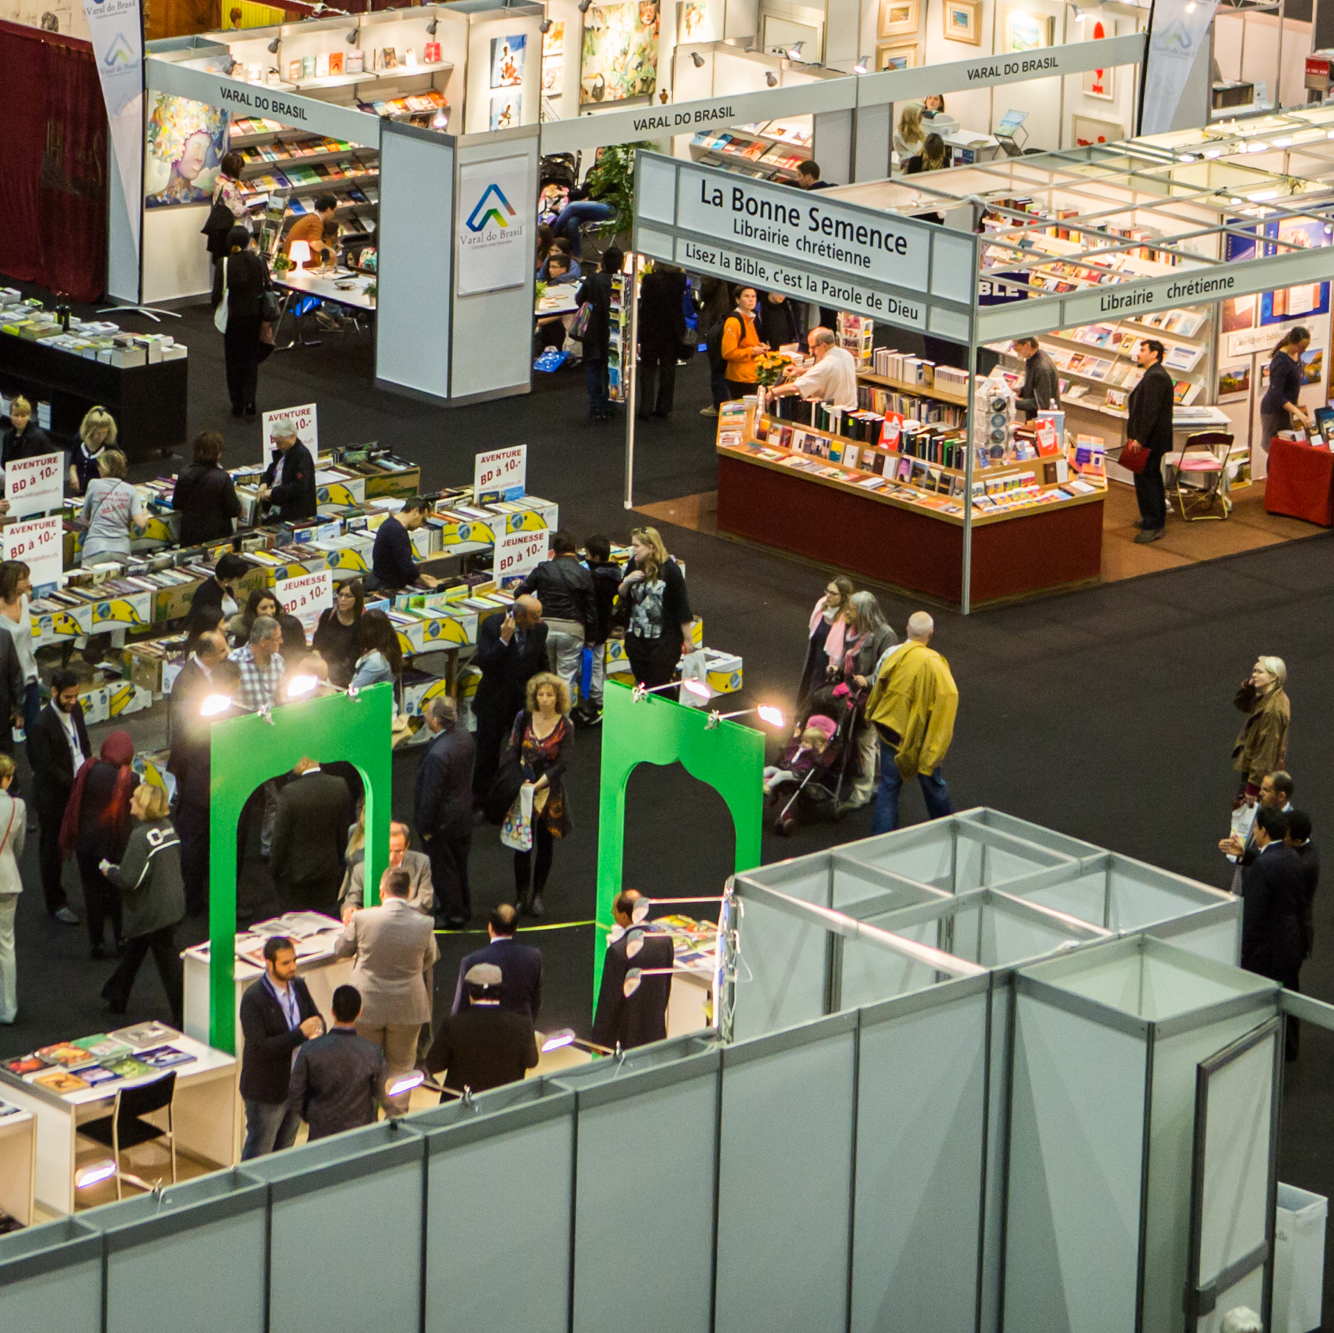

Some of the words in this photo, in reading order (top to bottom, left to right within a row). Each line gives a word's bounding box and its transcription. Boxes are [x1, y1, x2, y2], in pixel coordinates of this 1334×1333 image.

[86, 3, 106, 17] Varal
[106, 2, 115, 13] do
[966, 64, 1005, 82] VARAL
[1006, 61, 1023, 78] DO
[1023, 56, 1060, 75] BRASIL
[219, 86, 253, 108] VARAL
[255, 95, 270, 111] DO
[272, 98, 308, 122] BRASIL
[632, 113, 673, 132] VARAL
[674, 111, 692, 127] DO
[693, 105, 736, 125] BRASIL
[701, 179, 725, 208] La
[732, 189, 800, 227] Bonne
[808, 208, 908, 257] Semence
[459, 233, 484, 247] Varal
[485, 232, 497, 244] do
[499, 226, 524, 242] Brasil
[733, 218, 790, 248] Librairie
[795, 234, 871, 269] chrétienne
[685, 243, 718, 265] Lisez
[720, 249, 732, 266] la
[735, 253, 768, 280] Bible,
[773, 264, 804, 286] c'est
[807, 270, 819, 288] la
[822, 273, 865, 304] Parole
[870, 286, 884, 306] de
[887, 296, 919, 321] Dieu
[1100, 288, 1154, 312] Librairie
[1166, 274, 1235, 300] chrétienne
[11, 455, 60, 473] AVENTURE
[480, 449, 523, 465] AVENTURE
[9, 520, 58, 537] AVENTURE
[501, 532, 545, 548] JEUNESSE
[282, 575, 328, 592] JEUNESSE
